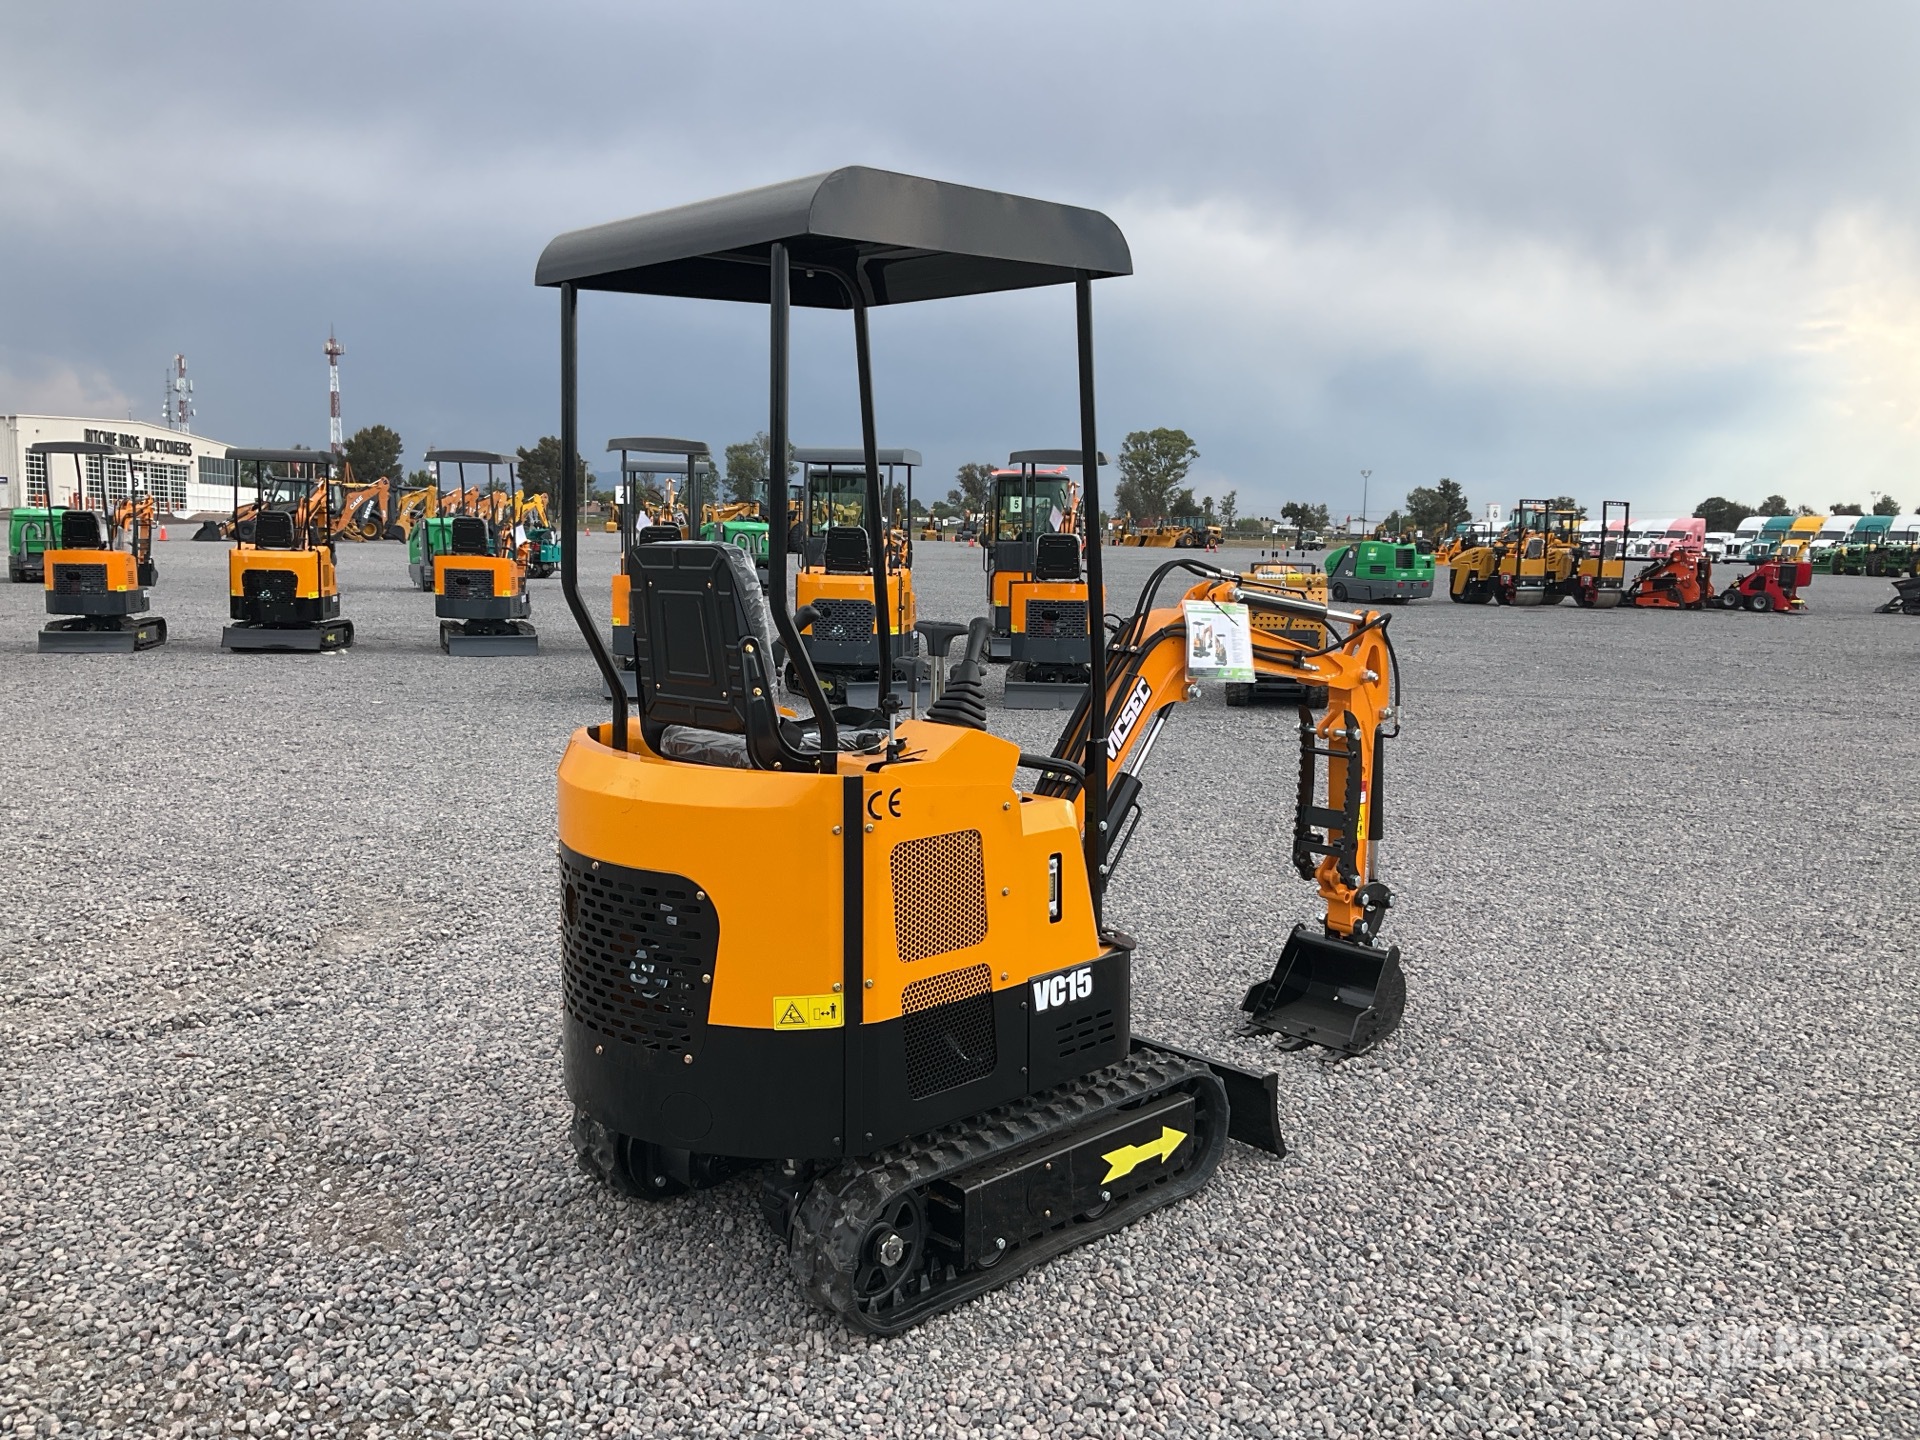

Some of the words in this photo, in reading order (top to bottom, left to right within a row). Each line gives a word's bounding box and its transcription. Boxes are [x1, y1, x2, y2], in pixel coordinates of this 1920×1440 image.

[84, 429, 117, 446] RITCHIE
[144, 437, 192, 456] AUCTIONEERS
[349, 495, 363, 510] CASE
[1014, 500, 1020, 509] 5
[1493, 510, 1497, 518] 6
[867, 787, 902, 820] CE
[1033, 967, 1092, 1012] VC15
